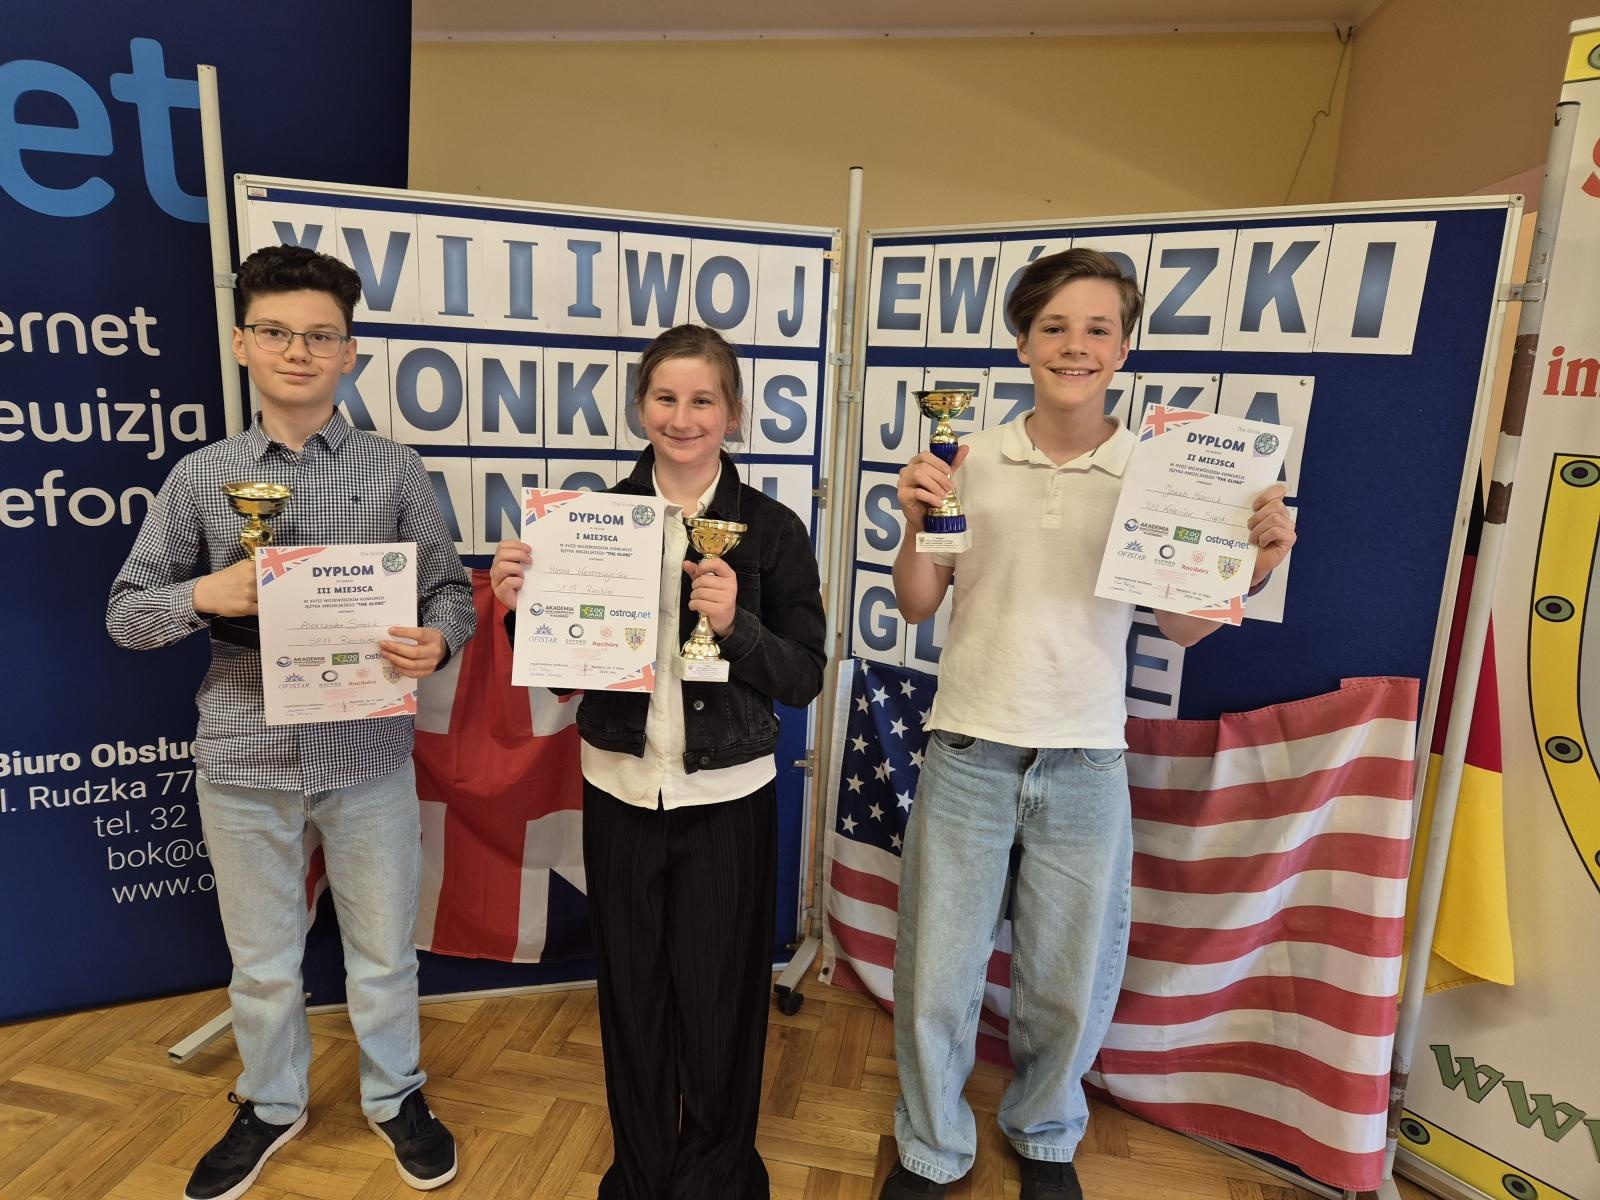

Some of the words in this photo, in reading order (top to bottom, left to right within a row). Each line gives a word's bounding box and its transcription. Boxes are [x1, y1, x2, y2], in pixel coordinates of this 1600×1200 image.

[0, 37, 209, 223] et
[877, 241, 1397, 340] EWZKI
[1186, 431, 1246, 453] DYPLOM
[1187, 453, 1196, 462] II
[1198, 455, 1235, 469] MIEJSCA
[569, 511, 624, 526] DYPLOM
[1140, 522, 1169, 532] AKADEMIA
[583, 533, 618, 542] MIEJSCA
[312, 564, 374, 577] DYPLOM
[334, 585, 374, 594] MIEJSCA
[609, 608, 652, 620] ostrog.net
[29, 778, 147, 810] Rudzka
[156, 769, 194, 796] 77
[93, 810, 139, 838] tel.
[150, 805, 188, 830] 32
[1429, 1044, 1600, 1163] ww
